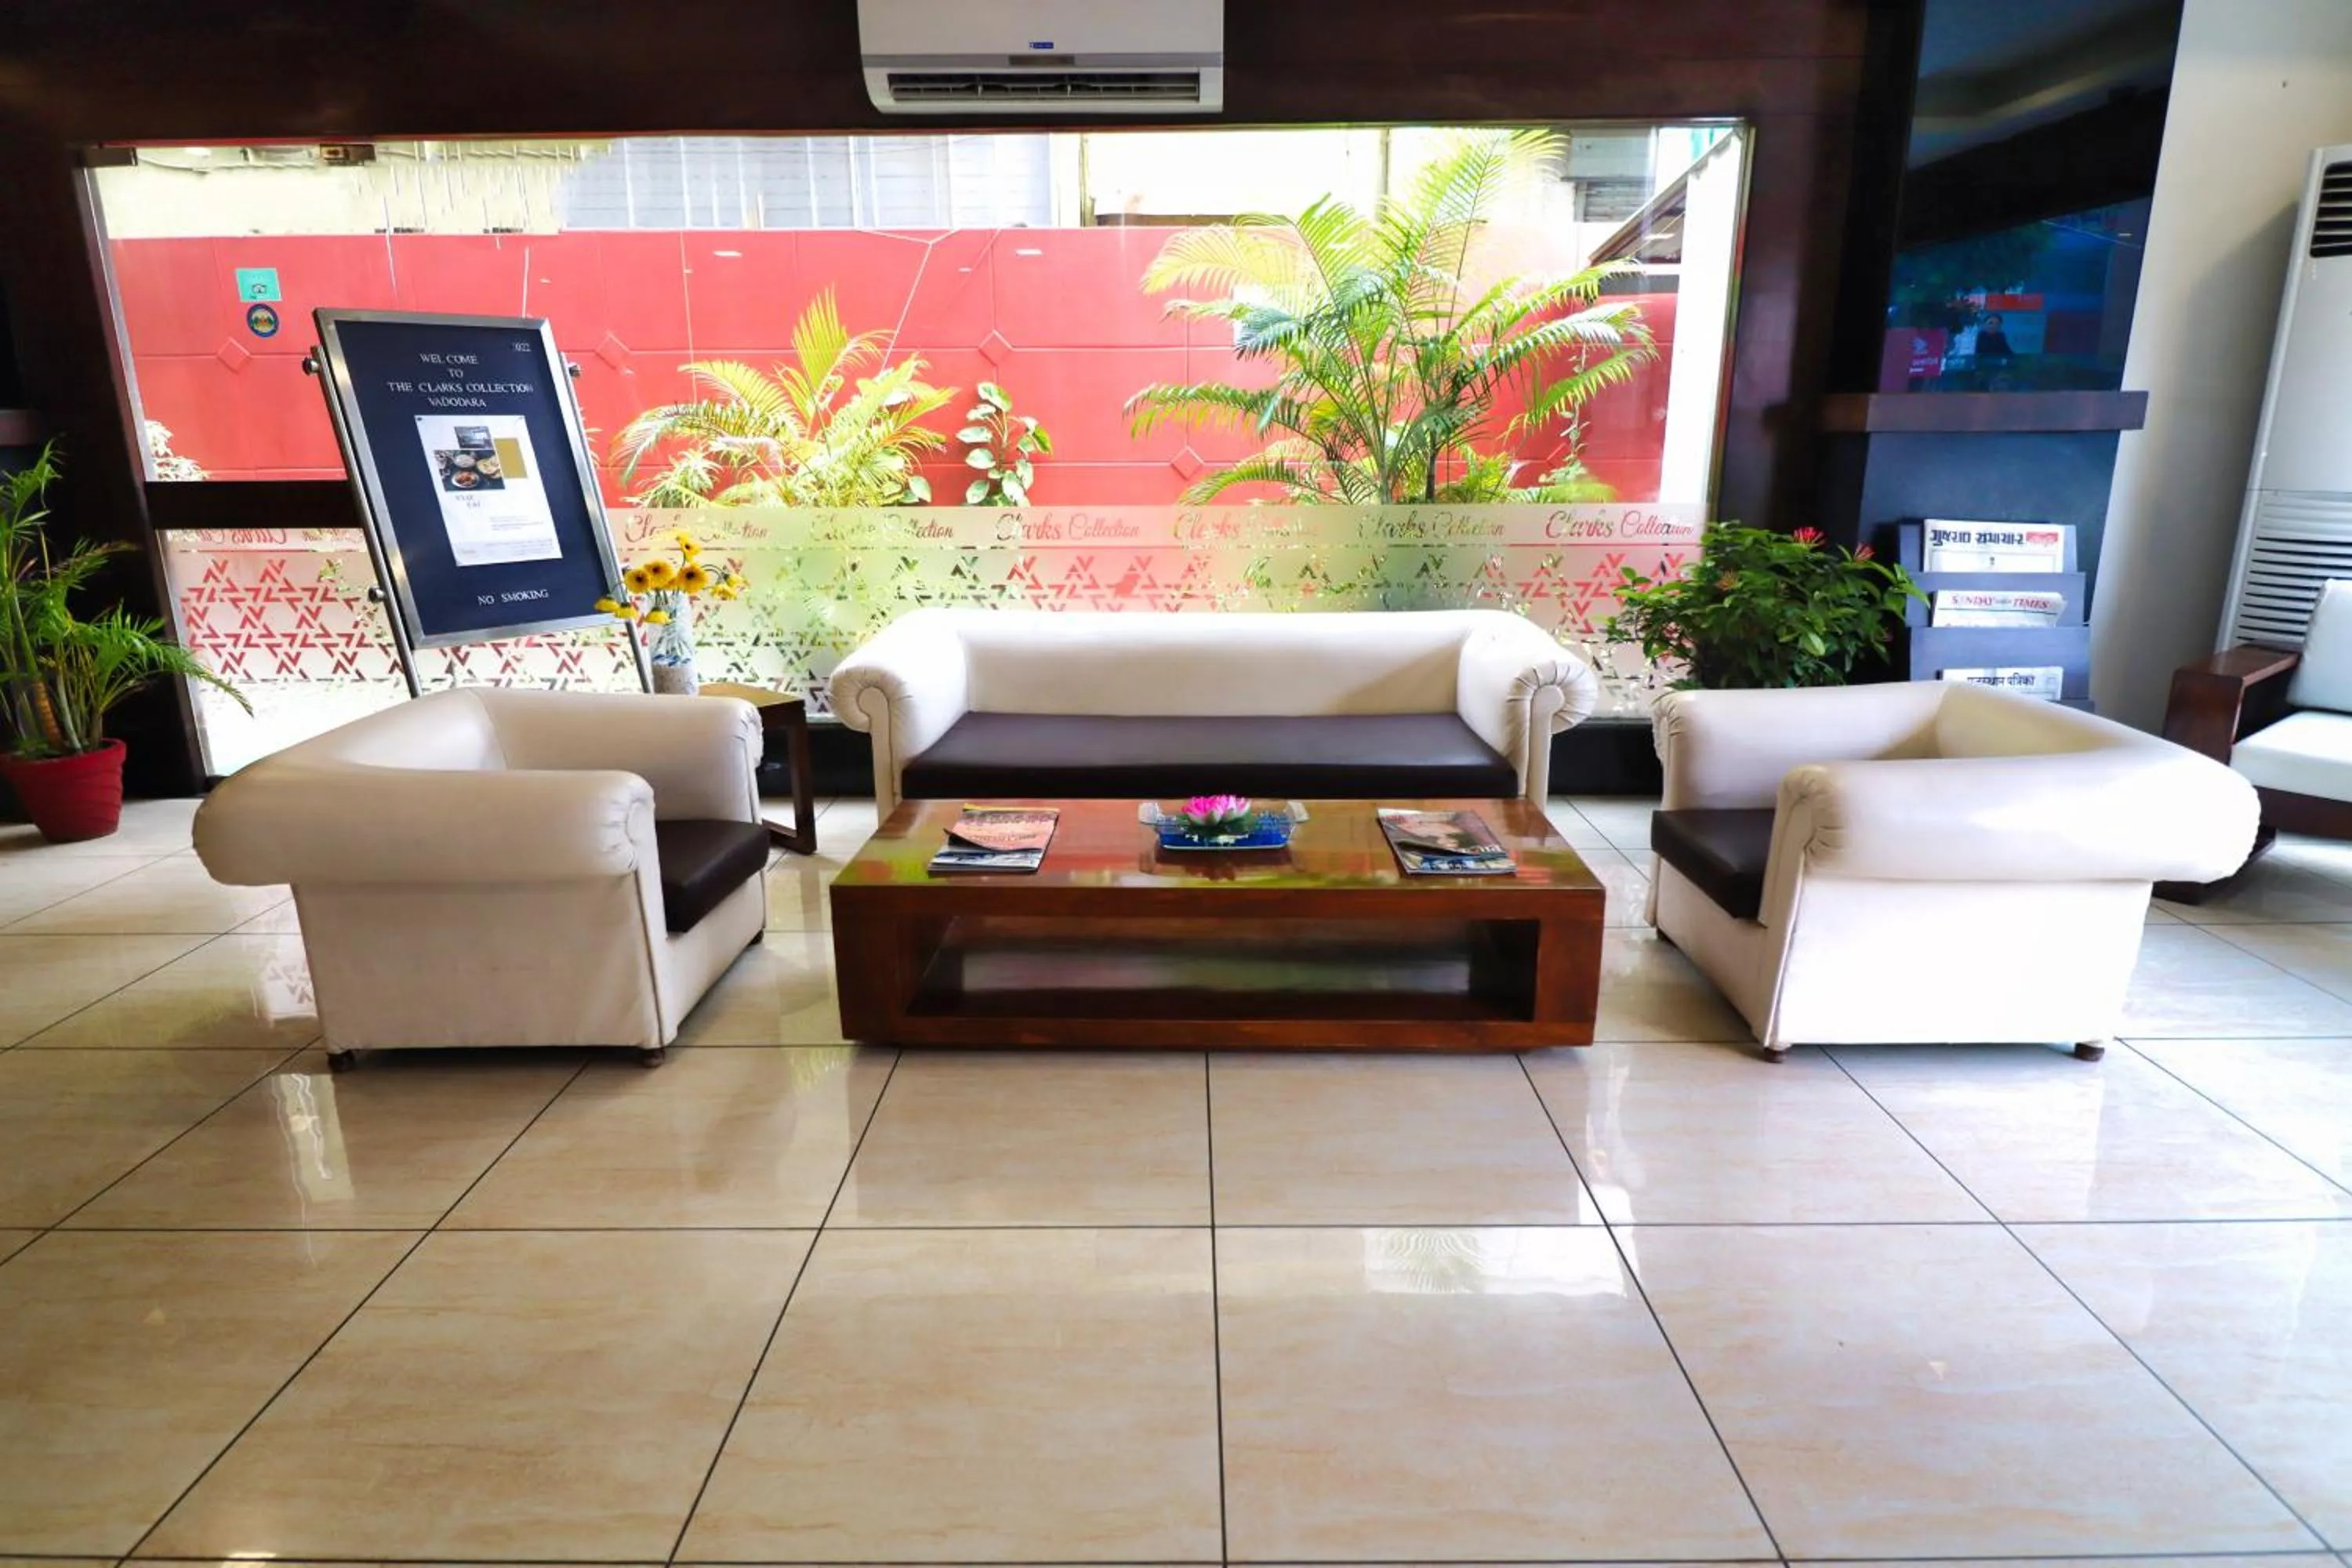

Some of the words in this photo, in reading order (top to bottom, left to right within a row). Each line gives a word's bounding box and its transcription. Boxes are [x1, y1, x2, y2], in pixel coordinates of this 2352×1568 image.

[447, 368, 464, 379] TO
[387, 382, 413, 392] THE
[418, 382, 463, 393] CLARKS
[466, 383, 534, 393] COLLECTION
[428, 396, 487, 408] VADODARA
[1069, 513, 1140, 539] Collection
[477, 595, 495, 606] NO
[501, 589, 549, 603] SMOKING
